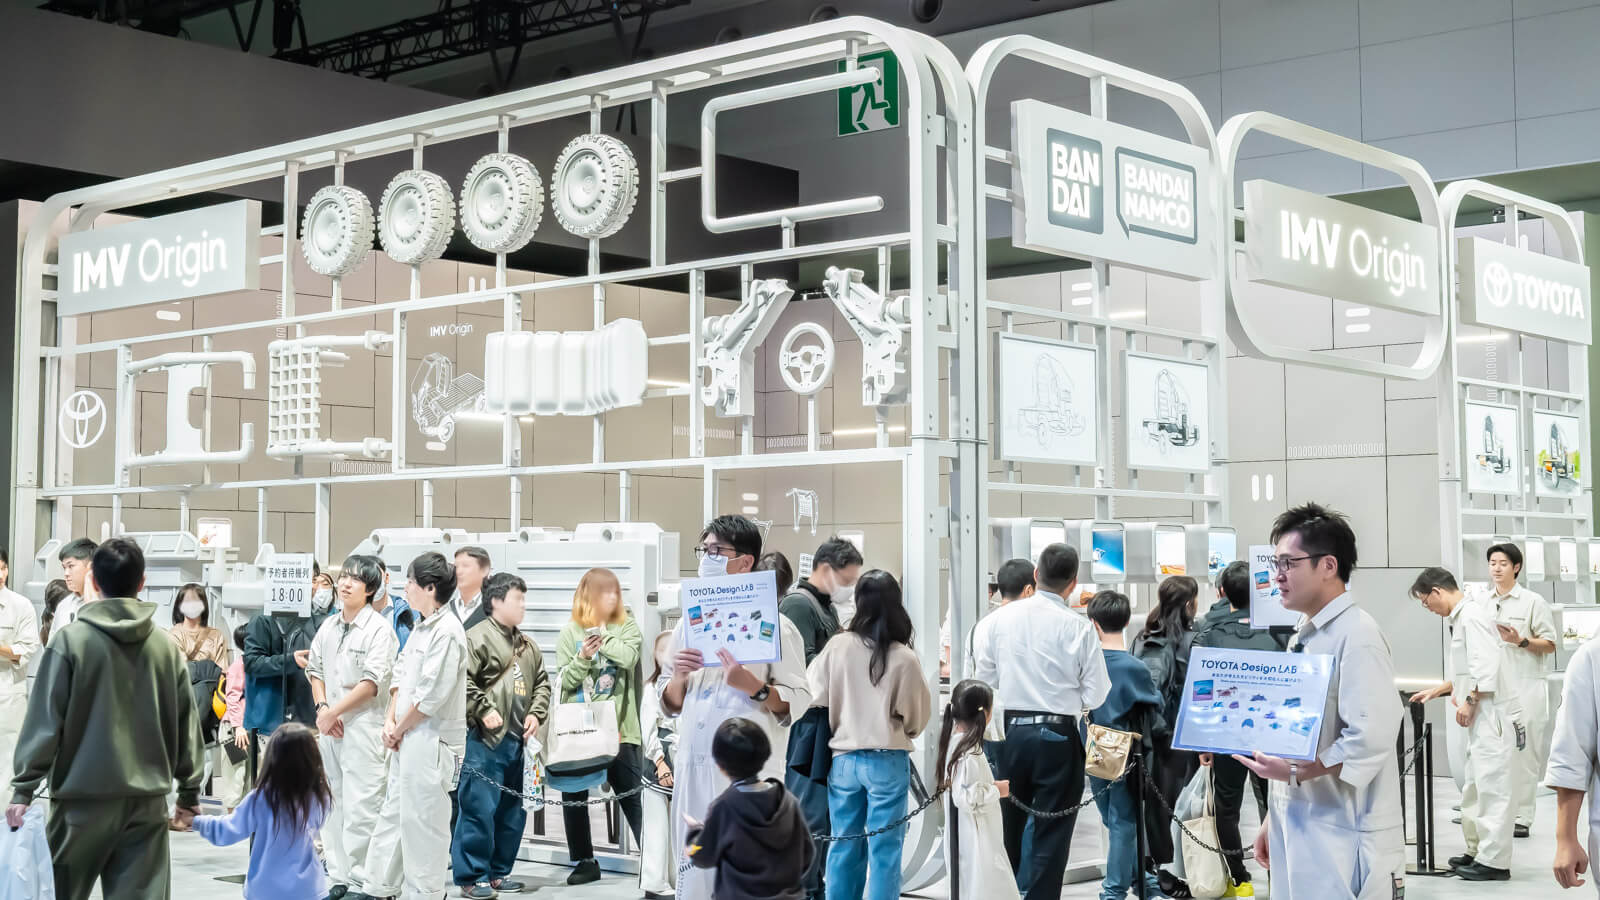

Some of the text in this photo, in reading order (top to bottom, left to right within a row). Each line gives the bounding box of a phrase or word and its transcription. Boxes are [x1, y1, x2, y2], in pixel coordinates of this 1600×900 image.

[1051, 142, 1100, 186] BAN
[1123, 163, 1189, 203] BANDAI
[1052, 178, 1091, 219] DAI
[1123, 191, 1191, 229] NAMCO
[72, 229, 228, 293] IMV Origin
[1280, 210, 1427, 297] IMV Origin
[1513, 271, 1585, 319] TOYOTA
[430, 322, 473, 337] IMV Origin
[271, 587, 303, 602] 18:00
[689, 587, 715, 597] TOYOTA
[716, 585, 740, 595] Design
[741, 583, 754, 591] LAB
[1201, 660, 1239, 671] TOYOTA
[1240, 662, 1277, 675] Design
[1278, 664, 1297, 674] LAB
